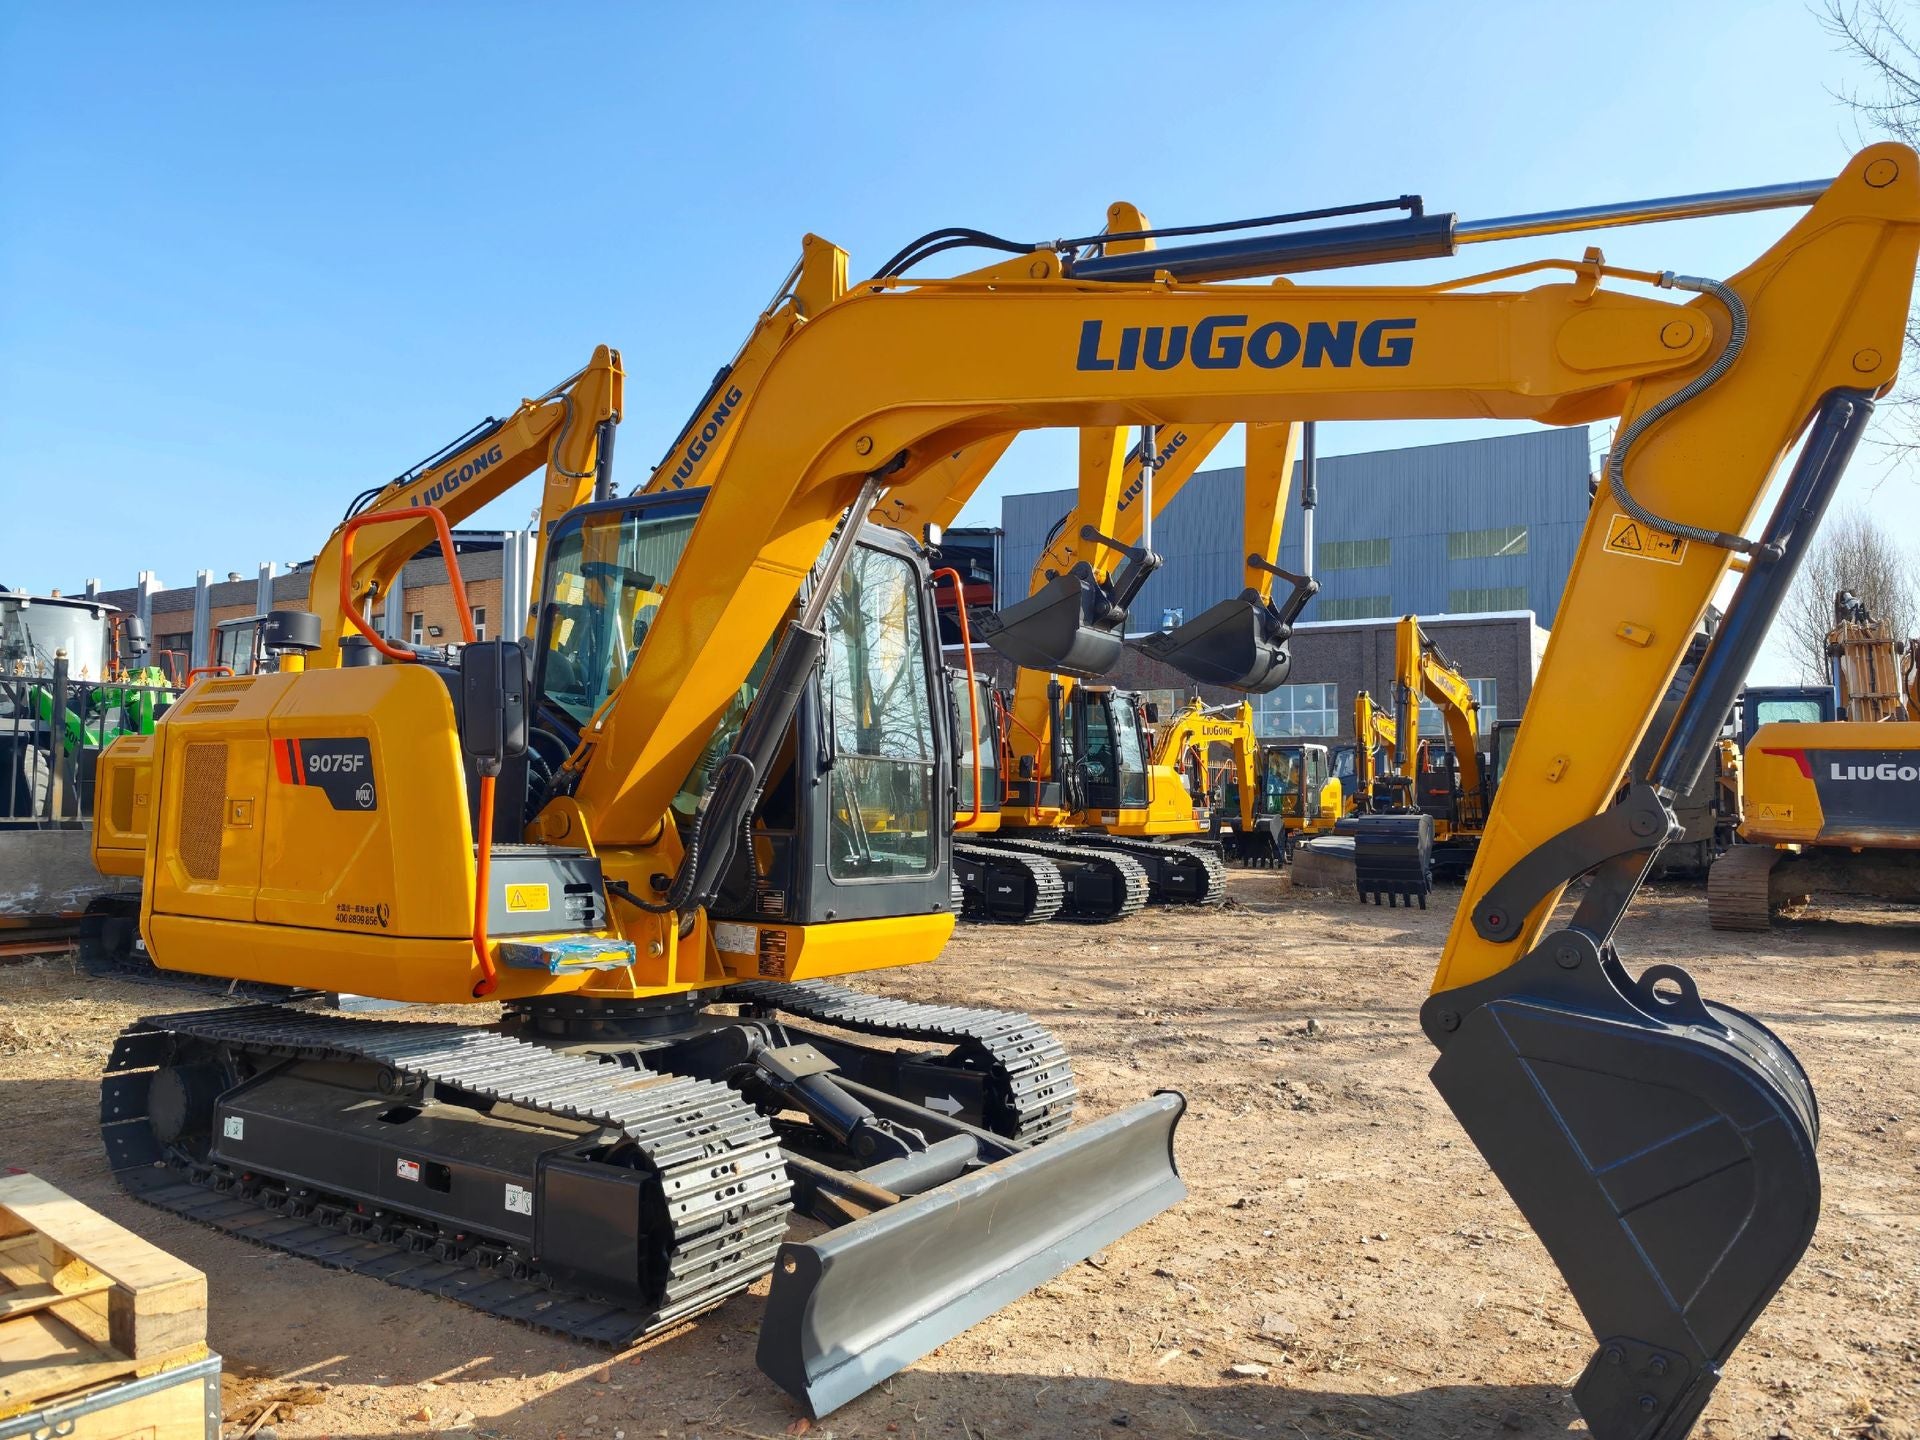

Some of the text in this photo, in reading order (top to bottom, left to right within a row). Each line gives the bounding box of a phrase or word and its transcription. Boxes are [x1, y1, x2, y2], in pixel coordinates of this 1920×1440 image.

[661, 384, 743, 492] IUGONG
[1117, 431, 1188, 511] LIUONG
[309, 754, 364, 772] 9075F
[1830, 763, 1920, 781] LIUGO
[355, 789, 370, 801] MAX
